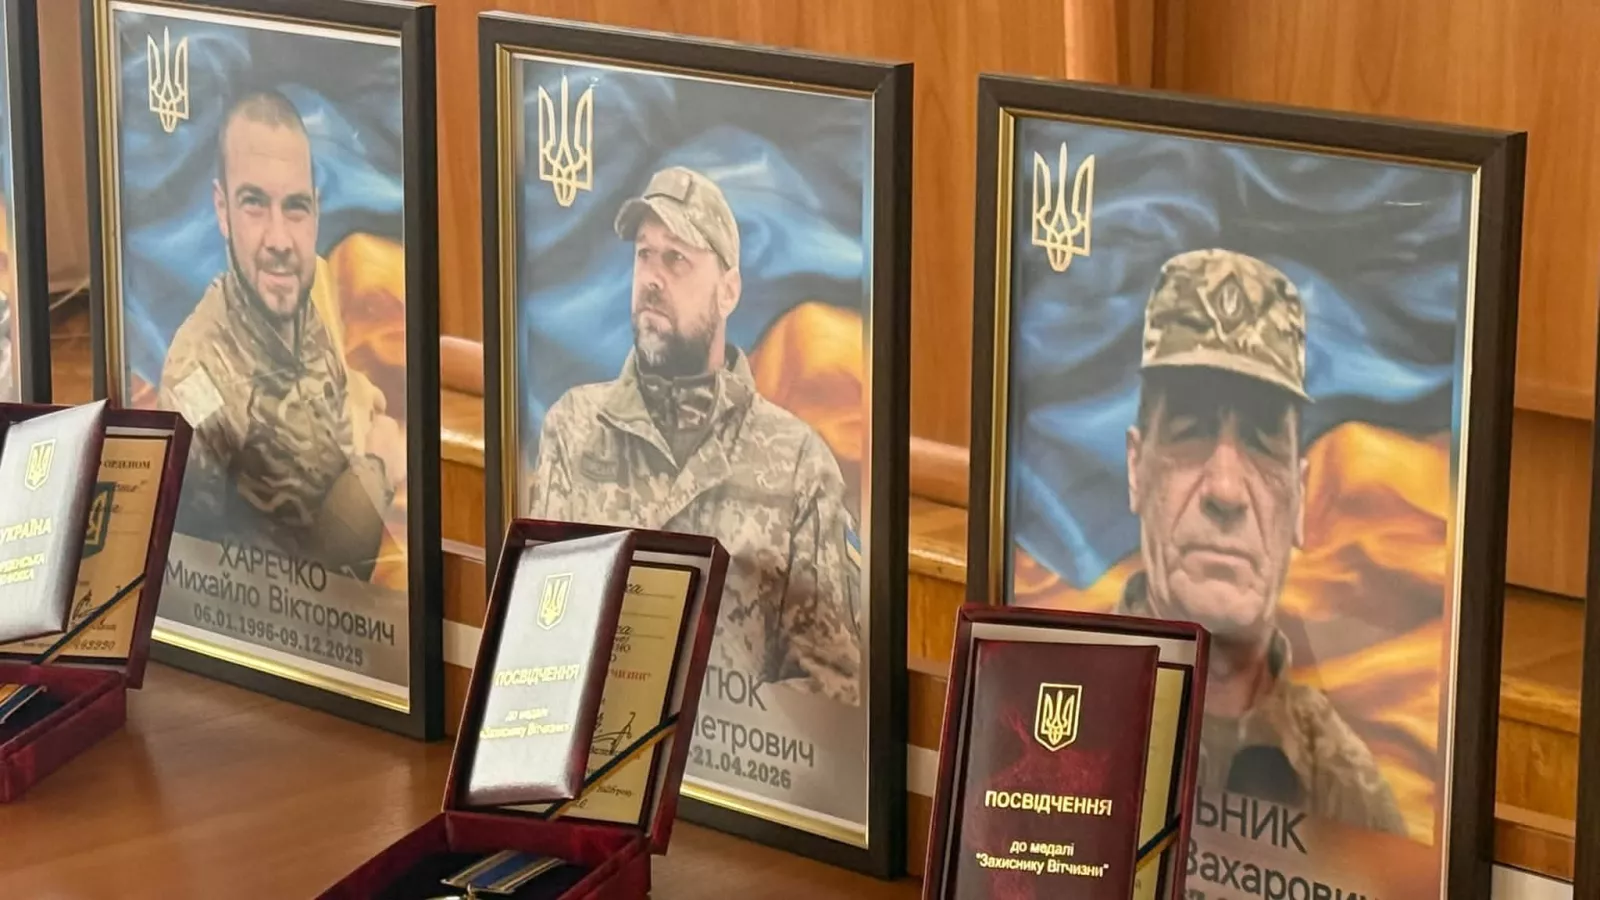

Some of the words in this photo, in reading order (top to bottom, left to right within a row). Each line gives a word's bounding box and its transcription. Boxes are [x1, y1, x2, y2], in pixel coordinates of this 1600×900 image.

[218, 539, 327, 593] ХАРЕЧКО
[165, 559, 261, 609] Михайло
[268, 587, 396, 647] Вікторович
[193, 603, 365, 667] 06.01.1996-09.12.2025
[494, 664, 580, 687] ПОСВІДЧЕННЯ
[985, 790, 1113, 816] ПОСВІДЧЕННЯ
[1195, 786, 1309, 855] ЬНИК
[975, 852, 1045, 875] "Захиснику
[1047, 859, 1110, 878] Вітчизни"
[1010, 841, 1028, 854] до
[1030, 842, 1075, 857] медалі
